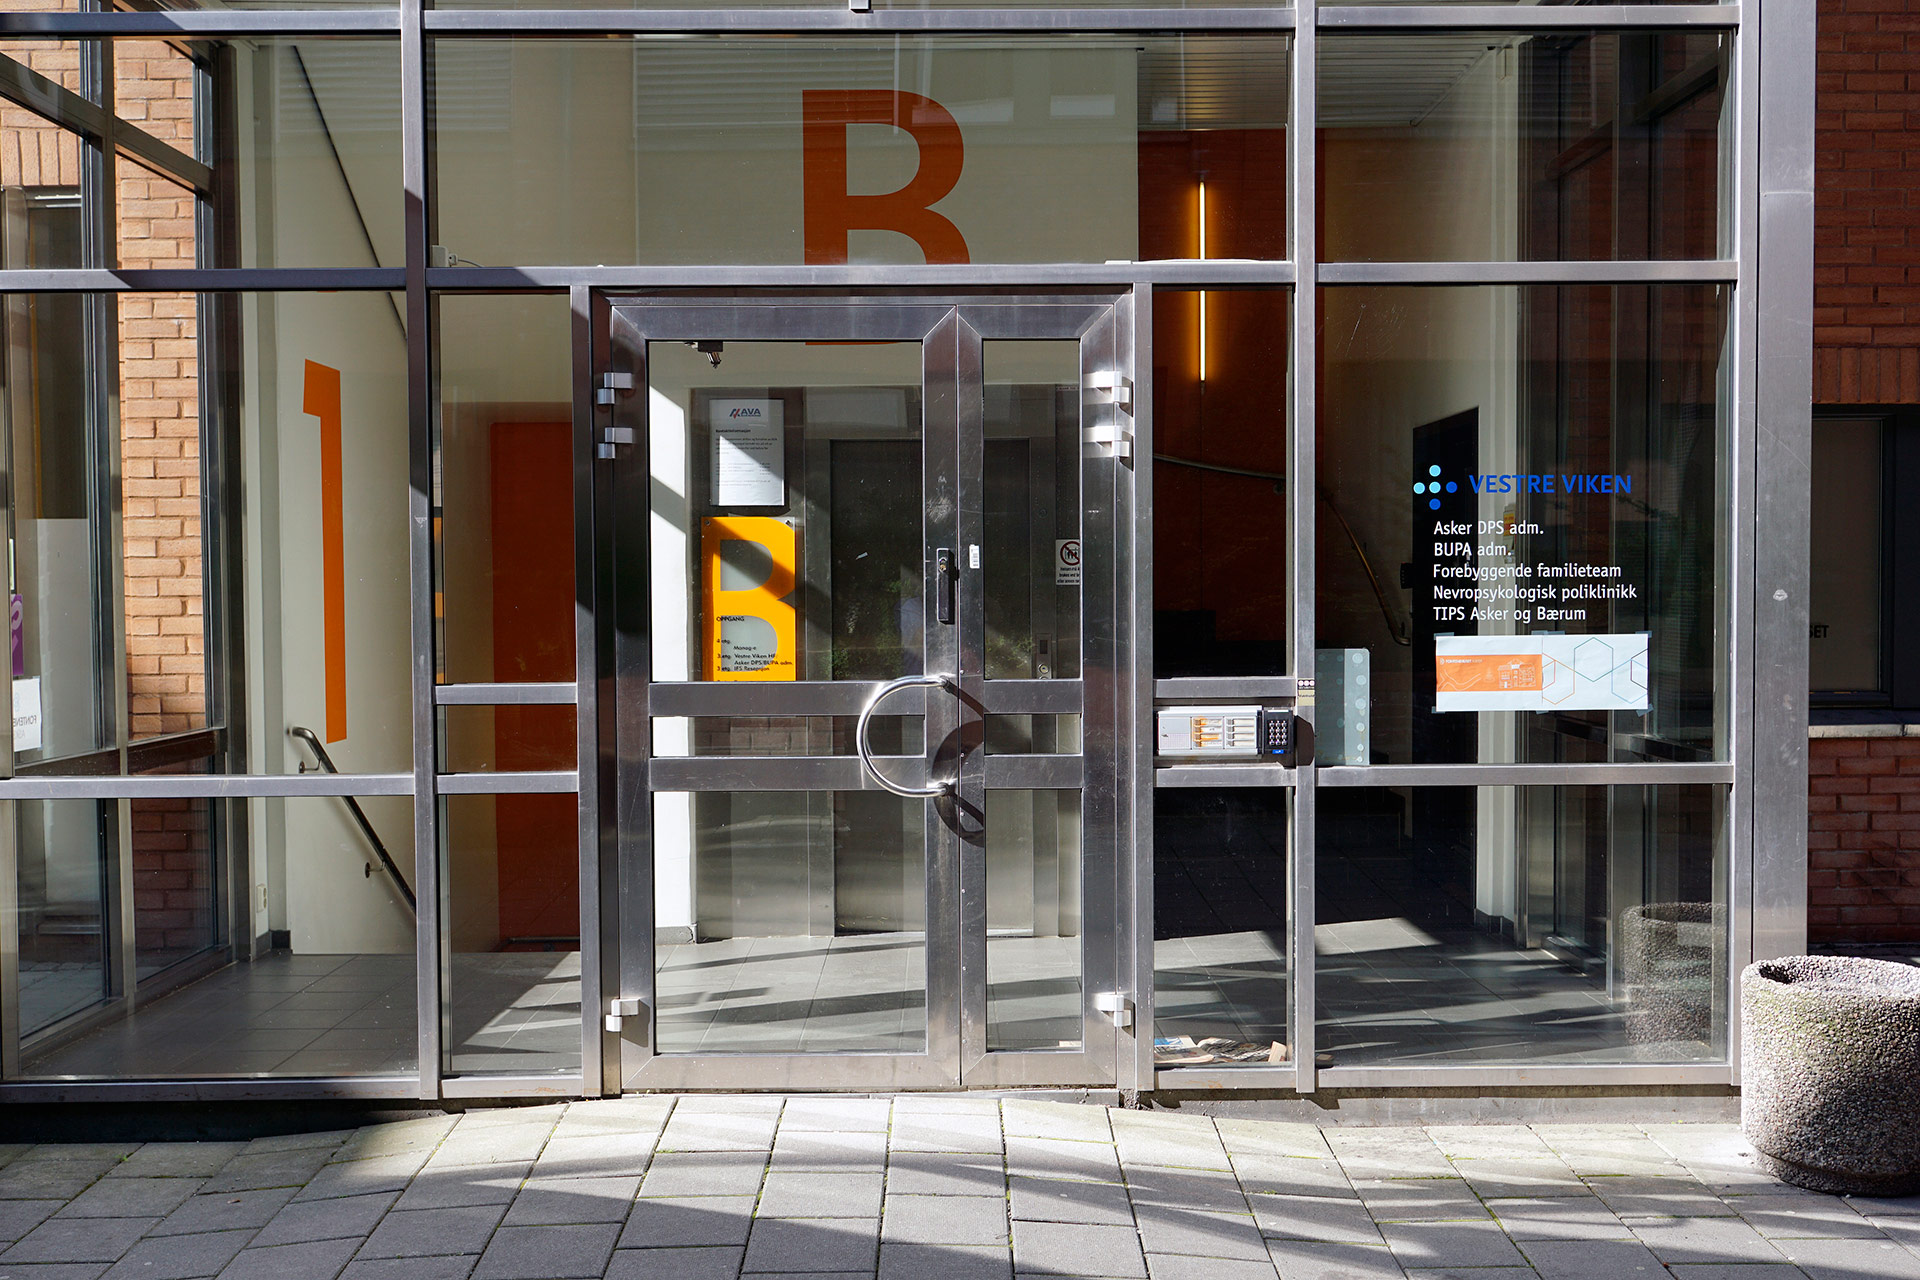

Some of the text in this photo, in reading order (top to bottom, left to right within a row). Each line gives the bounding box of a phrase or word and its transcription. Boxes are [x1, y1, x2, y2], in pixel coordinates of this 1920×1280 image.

[802, 89, 972, 345] B
[1469, 474, 1632, 494] VESTRE VIKEN
[1434, 520, 1472, 535] Asker
[1478, 520, 1504, 535] DPS
[1509, 520, 1544, 535] adm.
[1434, 542, 1513, 556] BUPA adm.
[1433, 563, 1622, 581] Forebyggende familieteam
[1433, 584, 1637, 602] Nevropsykologisk poliklinikk
[1433, 606, 1586, 624] TIPS Asker og Bærum
